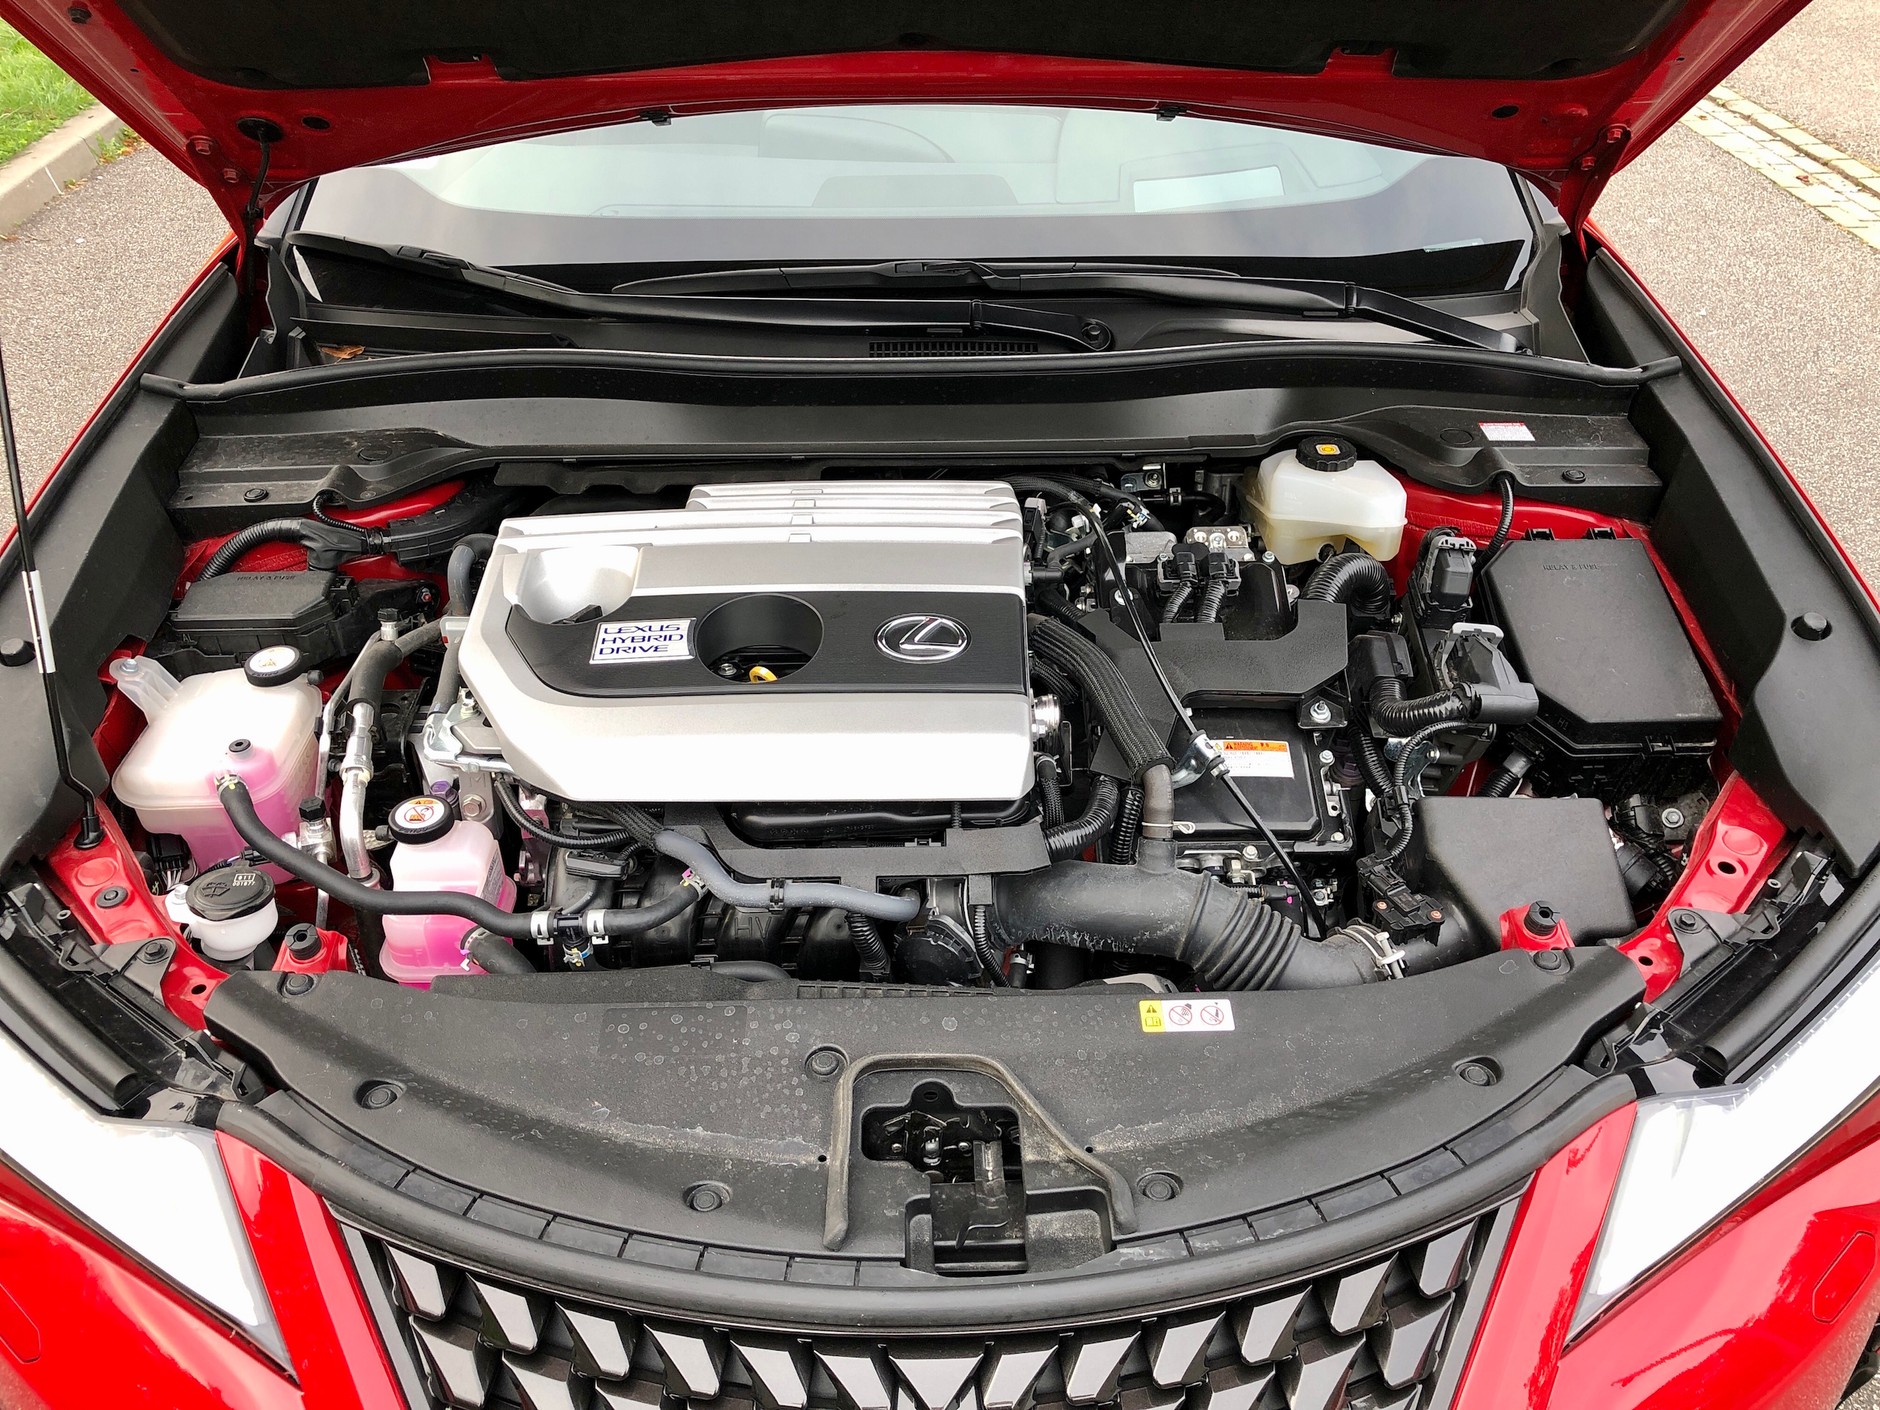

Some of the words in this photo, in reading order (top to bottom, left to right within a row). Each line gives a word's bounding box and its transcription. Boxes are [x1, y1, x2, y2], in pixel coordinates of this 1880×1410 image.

[603, 624, 681, 634] LEXUS
[601, 634, 684, 645] HYBRID
[599, 645, 669, 655] DRIVE
[734, 917, 773, 939] HV
